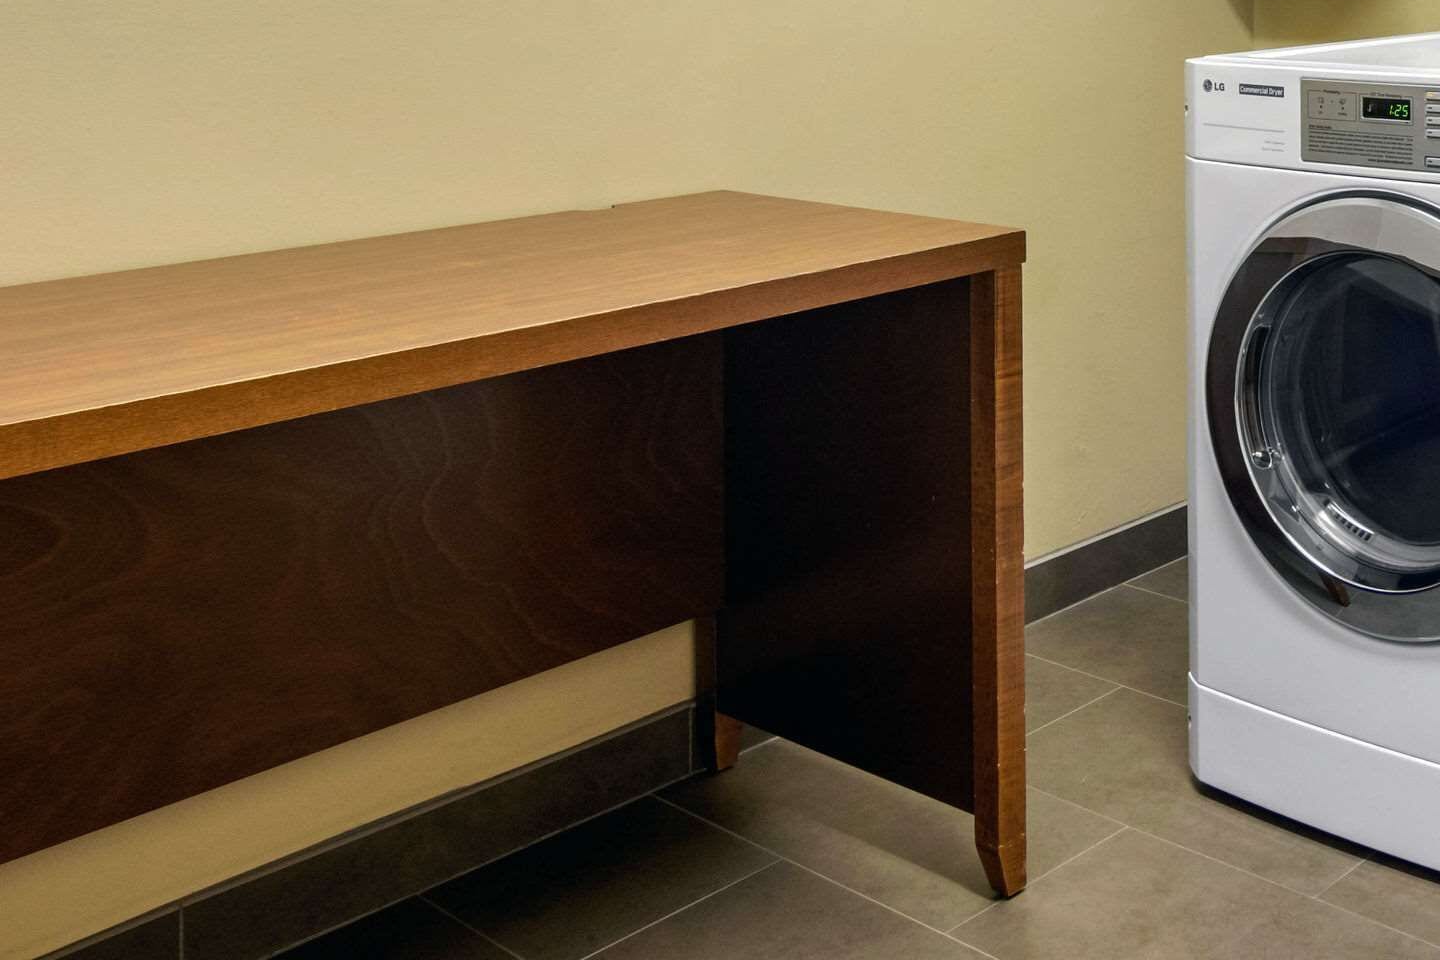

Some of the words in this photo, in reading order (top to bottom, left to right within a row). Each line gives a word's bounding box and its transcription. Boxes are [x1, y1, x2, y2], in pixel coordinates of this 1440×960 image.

[1214, 82, 1225, 91] LG
[1240, 86, 1269, 95] Commercial
[1269, 87, 1283, 96] Dryer
